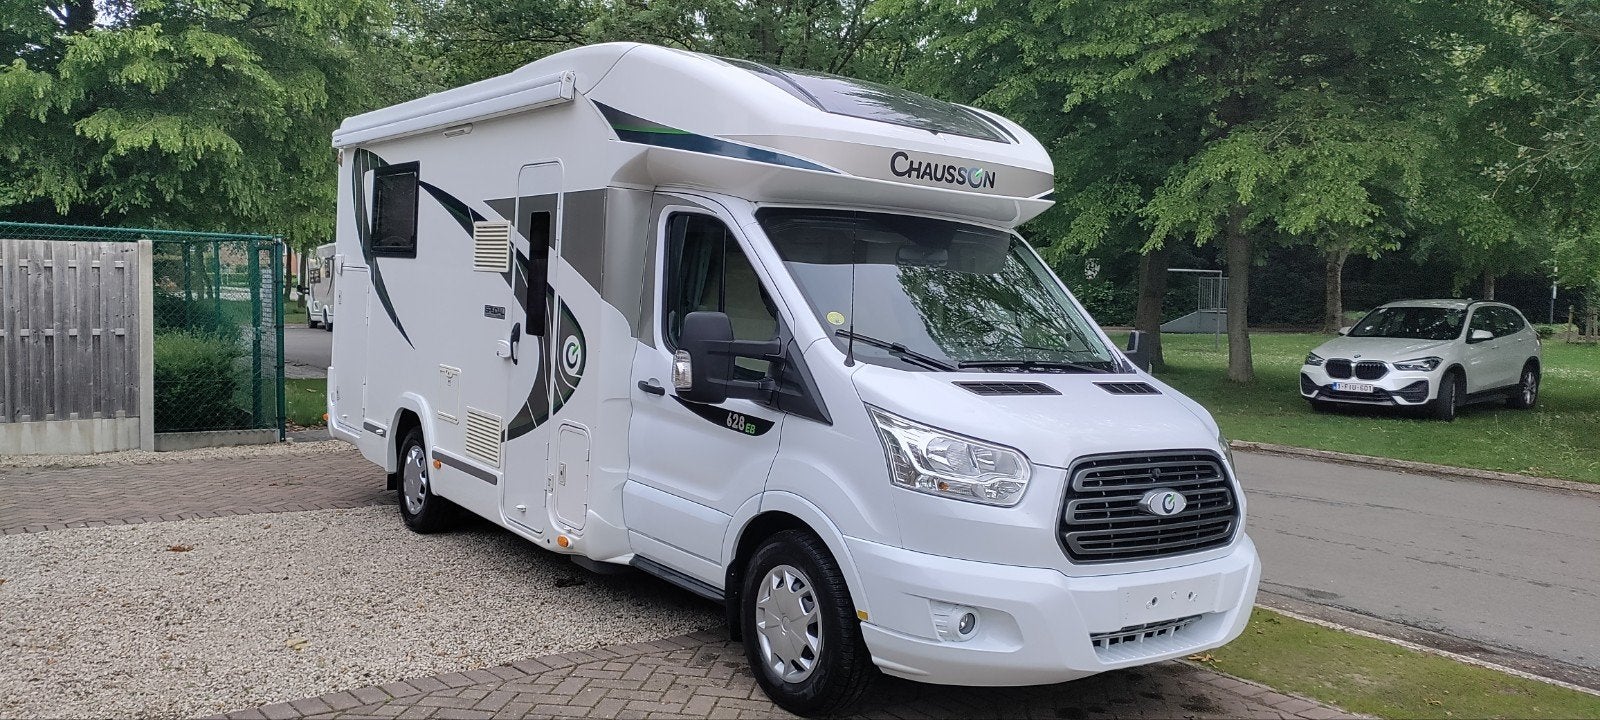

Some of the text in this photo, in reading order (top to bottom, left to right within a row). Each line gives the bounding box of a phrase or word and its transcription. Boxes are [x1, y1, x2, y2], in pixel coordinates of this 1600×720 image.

[890, 151, 996, 189] CHAUSSON
[726, 412, 756, 434] 628 EB
